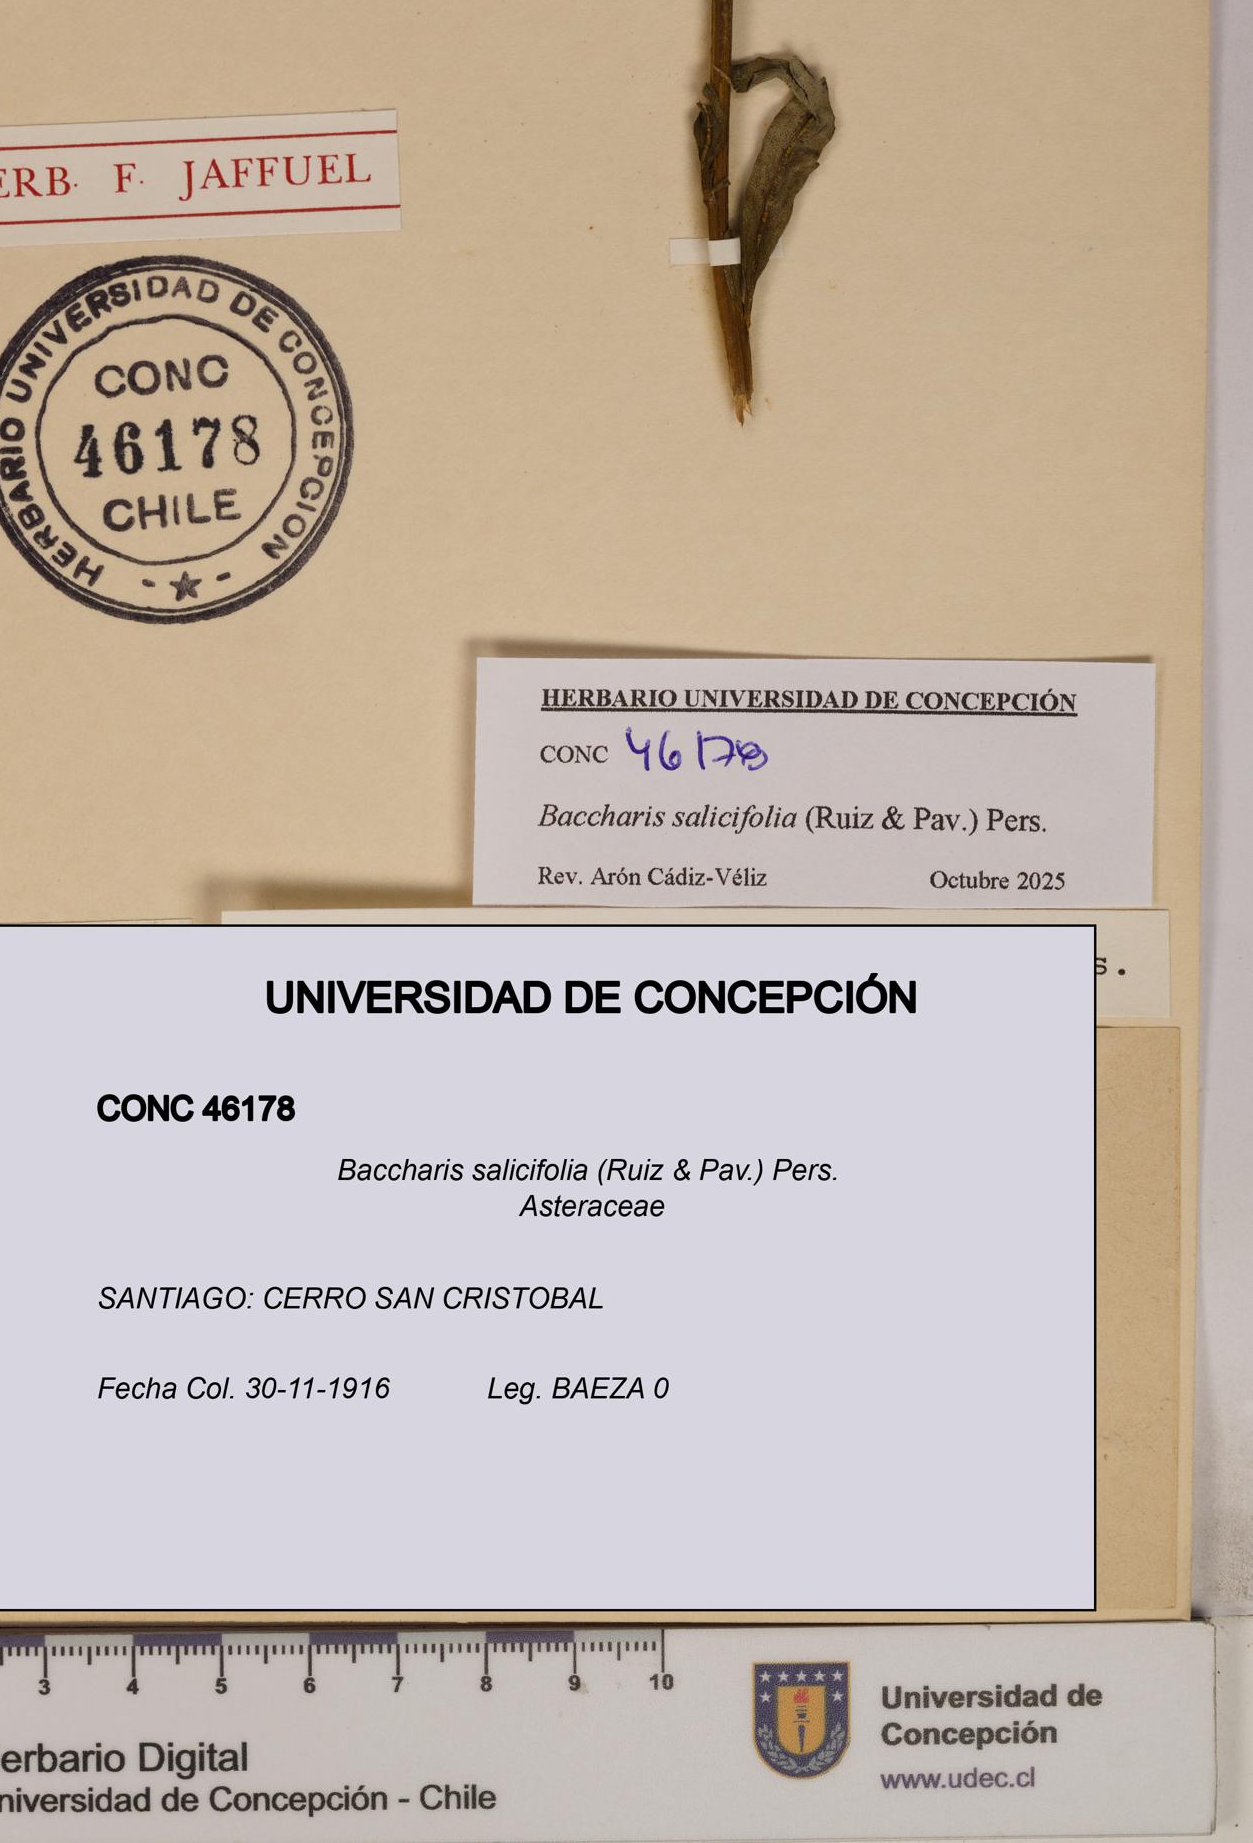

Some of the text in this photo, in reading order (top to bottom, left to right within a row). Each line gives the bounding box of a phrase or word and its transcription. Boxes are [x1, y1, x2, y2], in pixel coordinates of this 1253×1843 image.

[178, 153, 372, 202] JAFFUEL
[94, 354, 229, 399] CONC
[0, 274, 336, 588] HERBARIO UNIVERSIDAD DE CONCEPCION
[73, 414, 261, 479] 46178
[102, 487, 243, 533] CHILE
[541, 687, 1078, 712] HERBARIO UNIVERSIDAD DE CONCEPCIÓN
[540, 744, 609, 764] CONC
[537, 803, 1047, 837] Baccharis salicifolia (Ruiz & Pav.) Pers.
[537, 866, 768, 887] Rev. Arón Cádiz-Véliz
[929, 870, 1065, 891] Octubre 2025
[38, 1678, 51, 1696] 3
[125, 1677, 140, 1695] 4
[214, 1677, 228, 1695] 5
[303, 1676, 316, 1694] 6
[391, 1675, 404, 1693] 7
[479, 1675, 493, 1693] 8
[567, 1674, 582, 1692] 9
[649, 1671, 674, 1691] 10
[881, 1682, 1103, 1710] Universidad de
[880, 1720, 1058, 1751] Concepción
[138, 1741, 248, 1781] Digital
[880, 1766, 1036, 1790] www.udec.cl
[160, 1786, 200, 1813] de
[208, 1784, 388, 1818] Concepción
[419, 1783, 497, 1811] Chile
